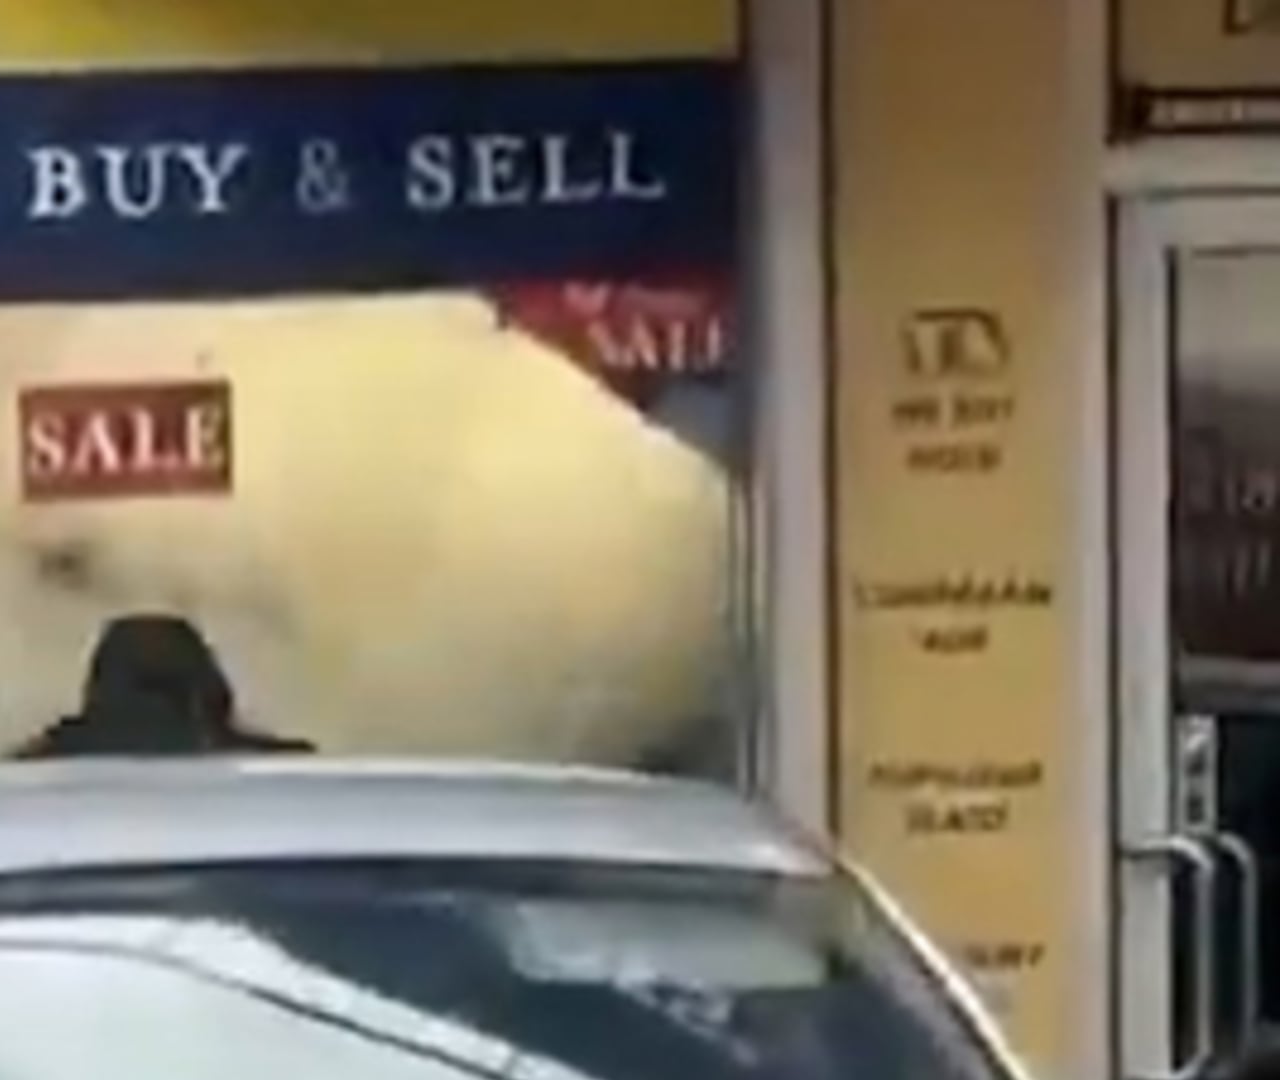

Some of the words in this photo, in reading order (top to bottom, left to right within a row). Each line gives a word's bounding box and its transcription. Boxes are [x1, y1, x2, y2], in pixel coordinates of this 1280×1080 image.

[26, 141, 247, 218] BUY
[295, 137, 350, 214] &
[406, 130, 666, 210] SELL
[28, 404, 225, 479] SALE
